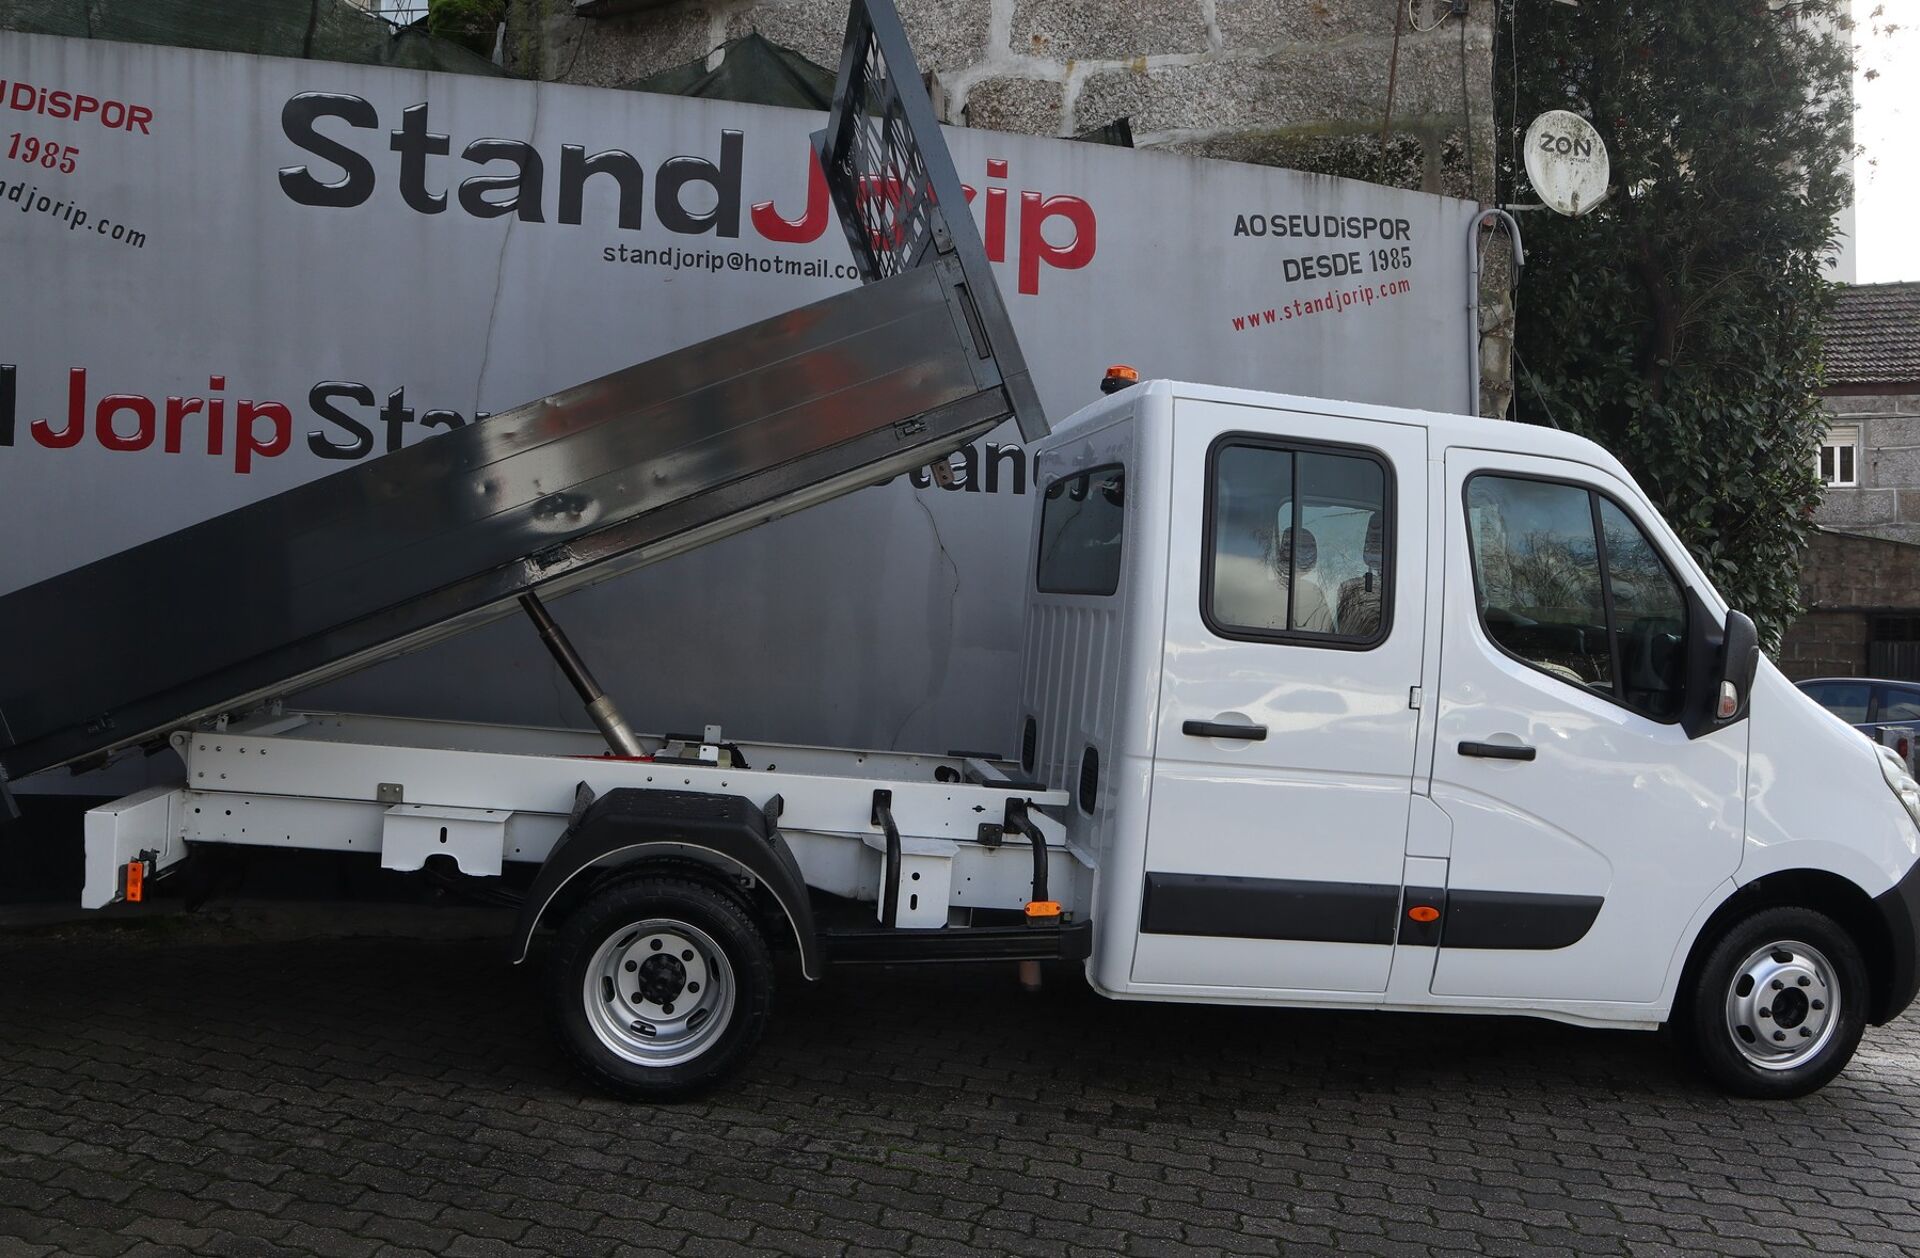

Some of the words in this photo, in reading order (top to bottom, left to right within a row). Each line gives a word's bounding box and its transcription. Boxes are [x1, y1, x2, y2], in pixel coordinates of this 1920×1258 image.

[7, 132, 80, 174] 1985
[1540, 131, 1592, 157] ZON
[602, 243, 860, 281] standjorip@hotmail.co
[1282, 251, 1363, 283] DESDE
[1368, 246, 1412, 272] 1985
[1232, 278, 1411, 332] www.standjorip.com
